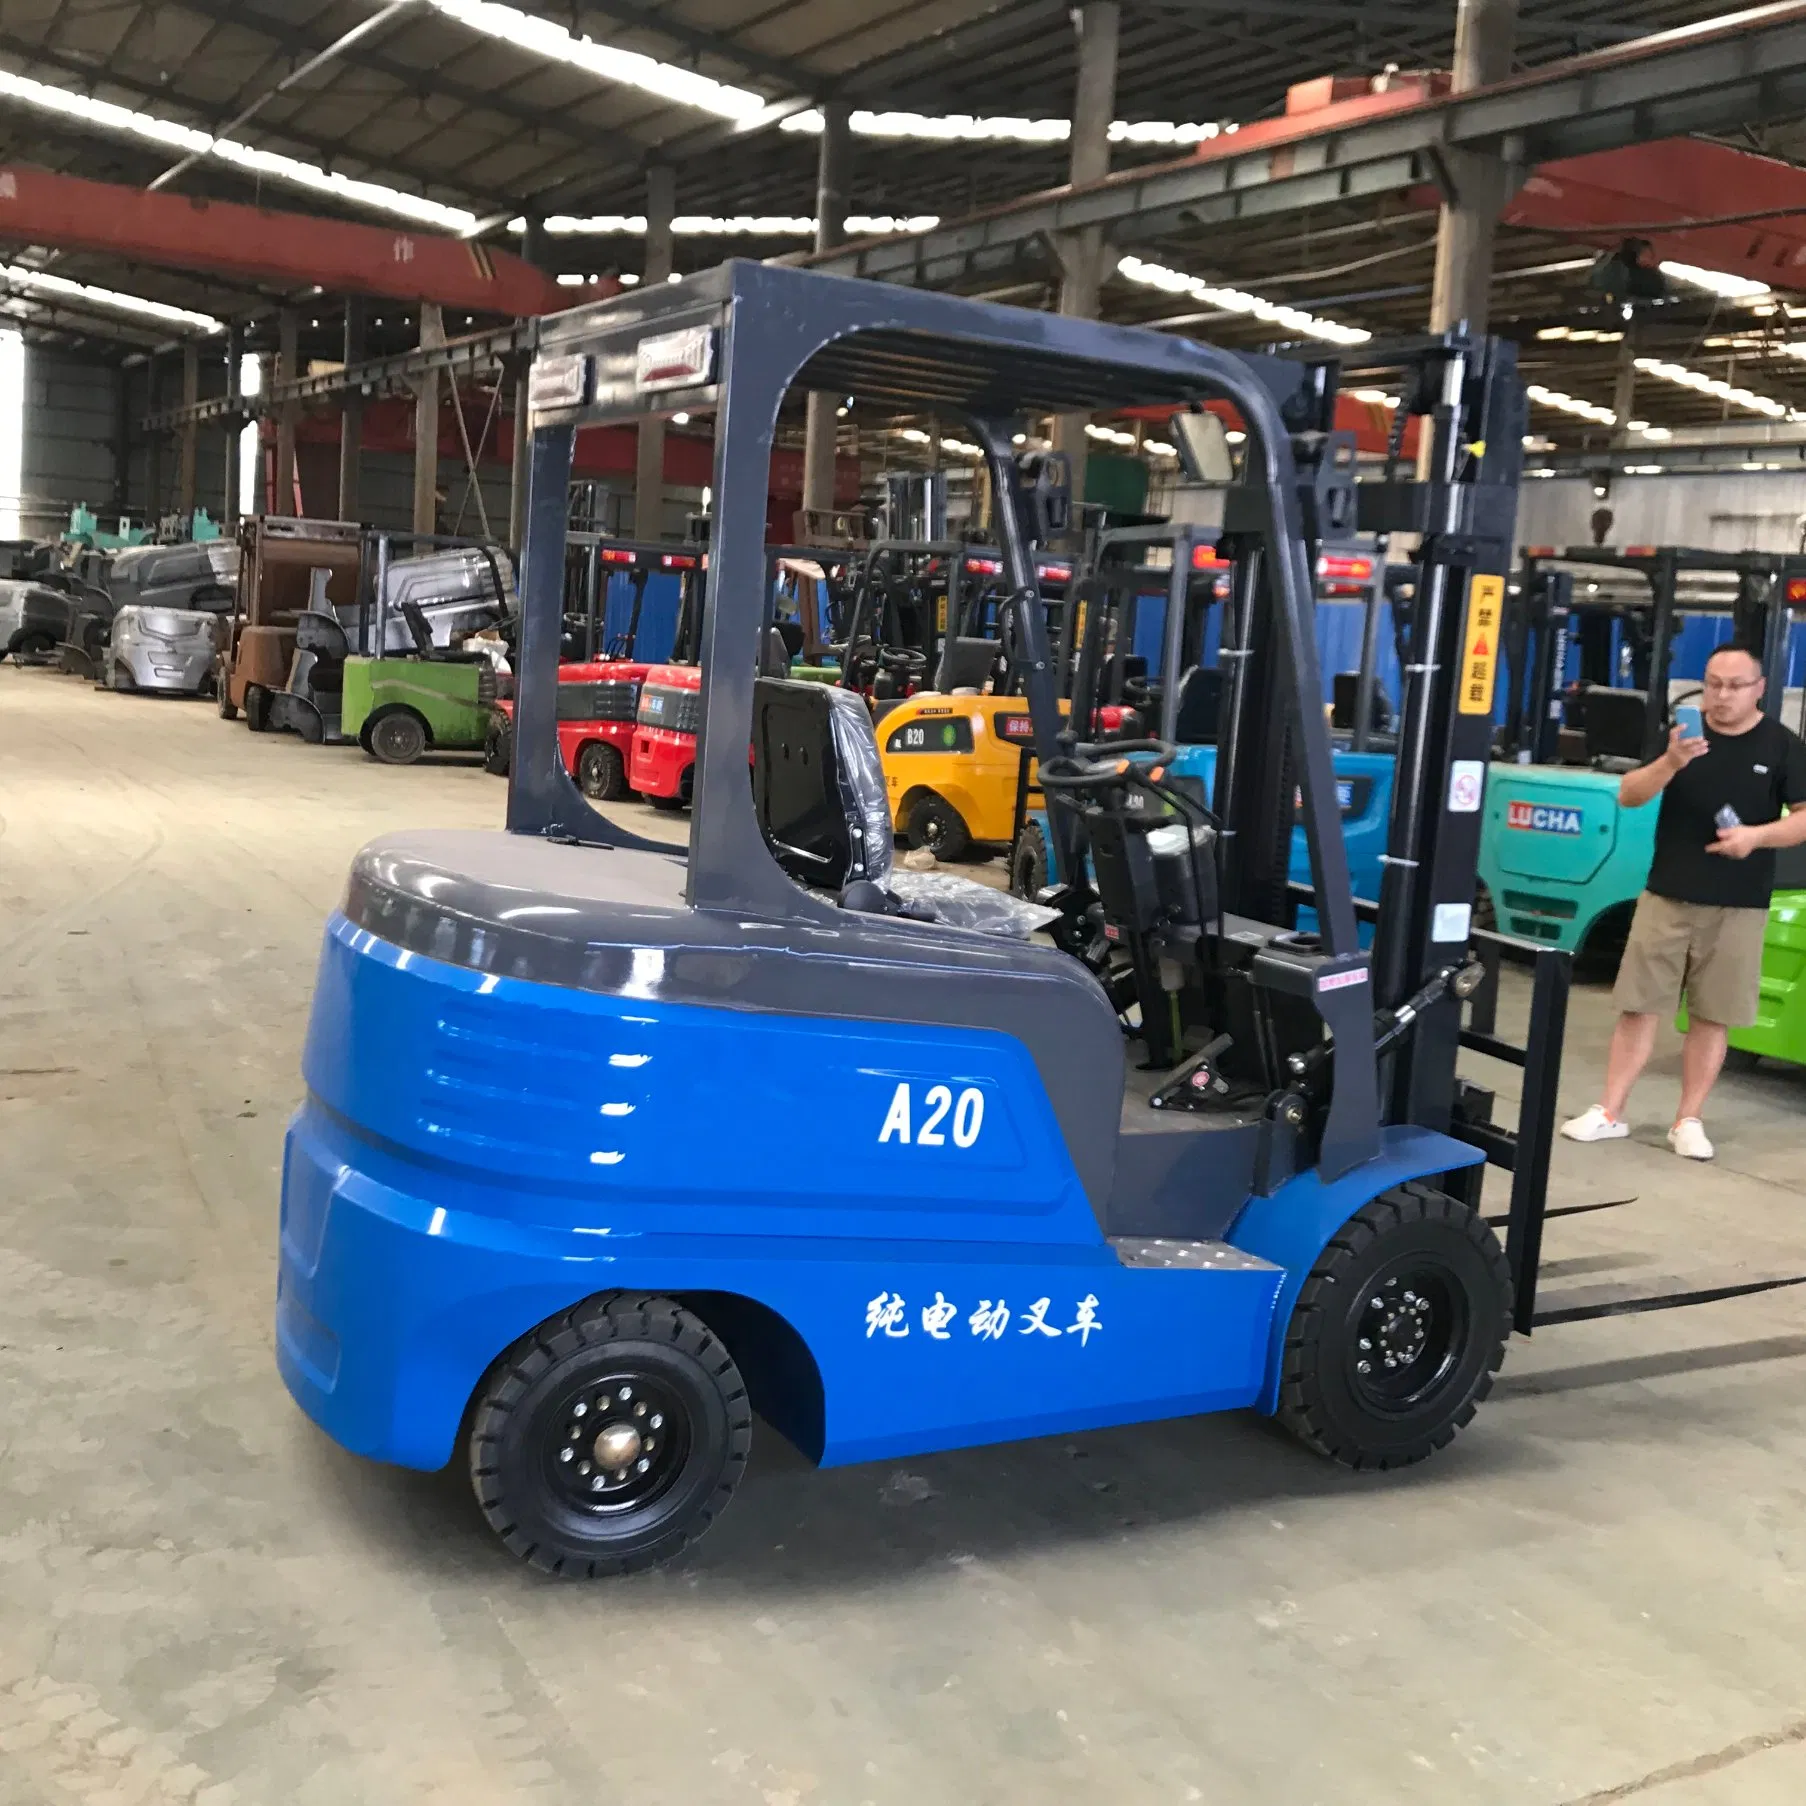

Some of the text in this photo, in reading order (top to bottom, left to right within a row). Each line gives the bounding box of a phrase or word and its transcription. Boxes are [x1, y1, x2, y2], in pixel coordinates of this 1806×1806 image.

[907, 728, 924, 745] B20
[1508, 804, 1580, 832] LUCHA
[878, 1083, 984, 1148] A20
[865, 1291, 1103, 1348] 纯电动叉车
